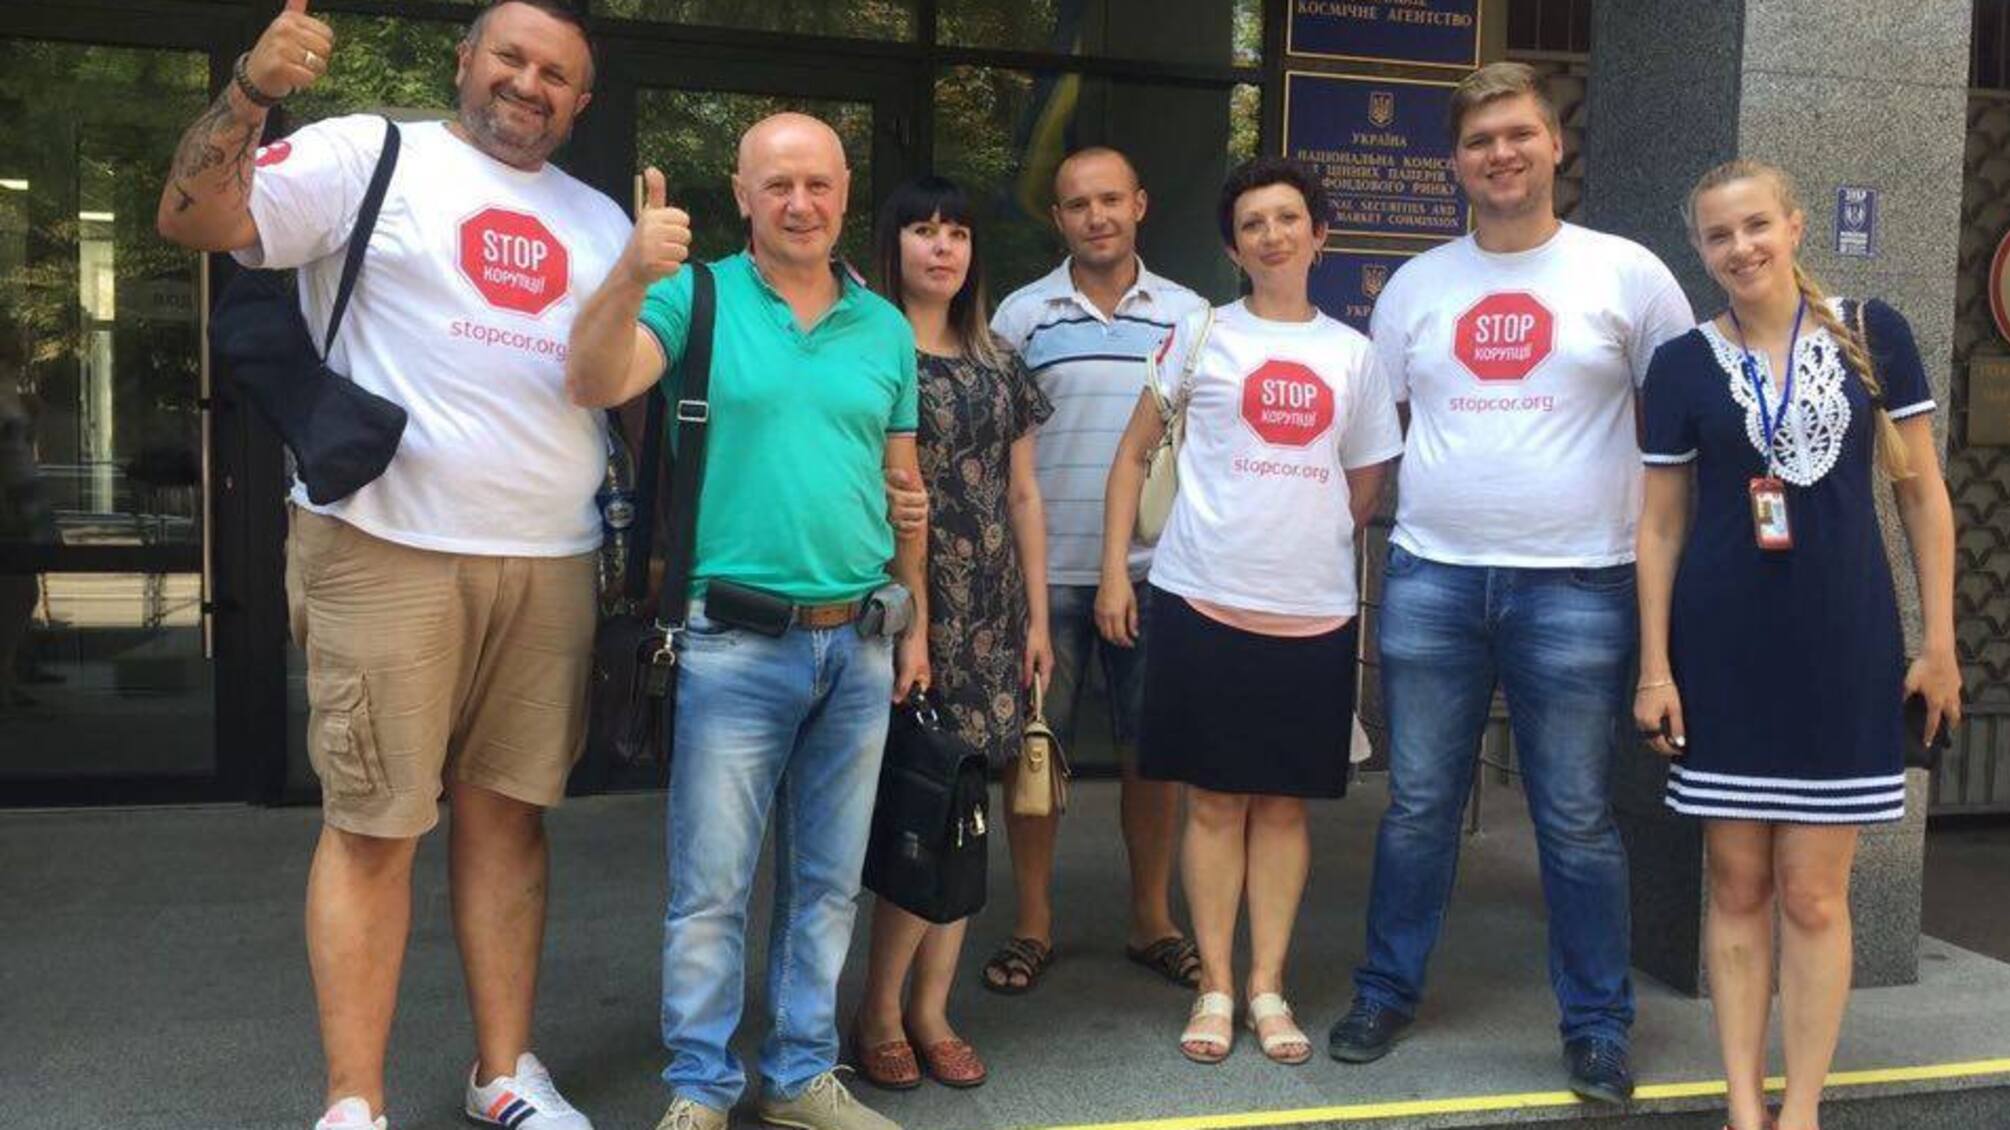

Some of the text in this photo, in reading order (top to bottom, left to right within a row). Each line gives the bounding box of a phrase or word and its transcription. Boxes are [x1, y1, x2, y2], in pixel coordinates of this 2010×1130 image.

[1297, 1, 1377, 20] КОСМІЧНЕ
[1387, 8, 1473, 27] АГЕНТСТВО
[1352, 132, 1408, 147] УКРАЇНА
[1298, 151, 1395, 167] НАЦІОНАЛЬНА
[1388, 168, 1447, 182] ПАПЕРІВ
[1412, 182, 1457, 196] РИНКУ
[1361, 200, 1425, 214] SECURITIES
[1430, 203, 1456, 215] AND
[1388, 214, 1460, 227] COMMISSION
[483, 229, 548, 270] STOP
[1475, 313, 1535, 343] STOP
[450, 320, 567, 362] stopcor.org
[1262, 379, 1318, 408] STOP
[1449, 395, 1554, 414] stopcor.org
[1233, 459, 1330, 483] stopcor.org
